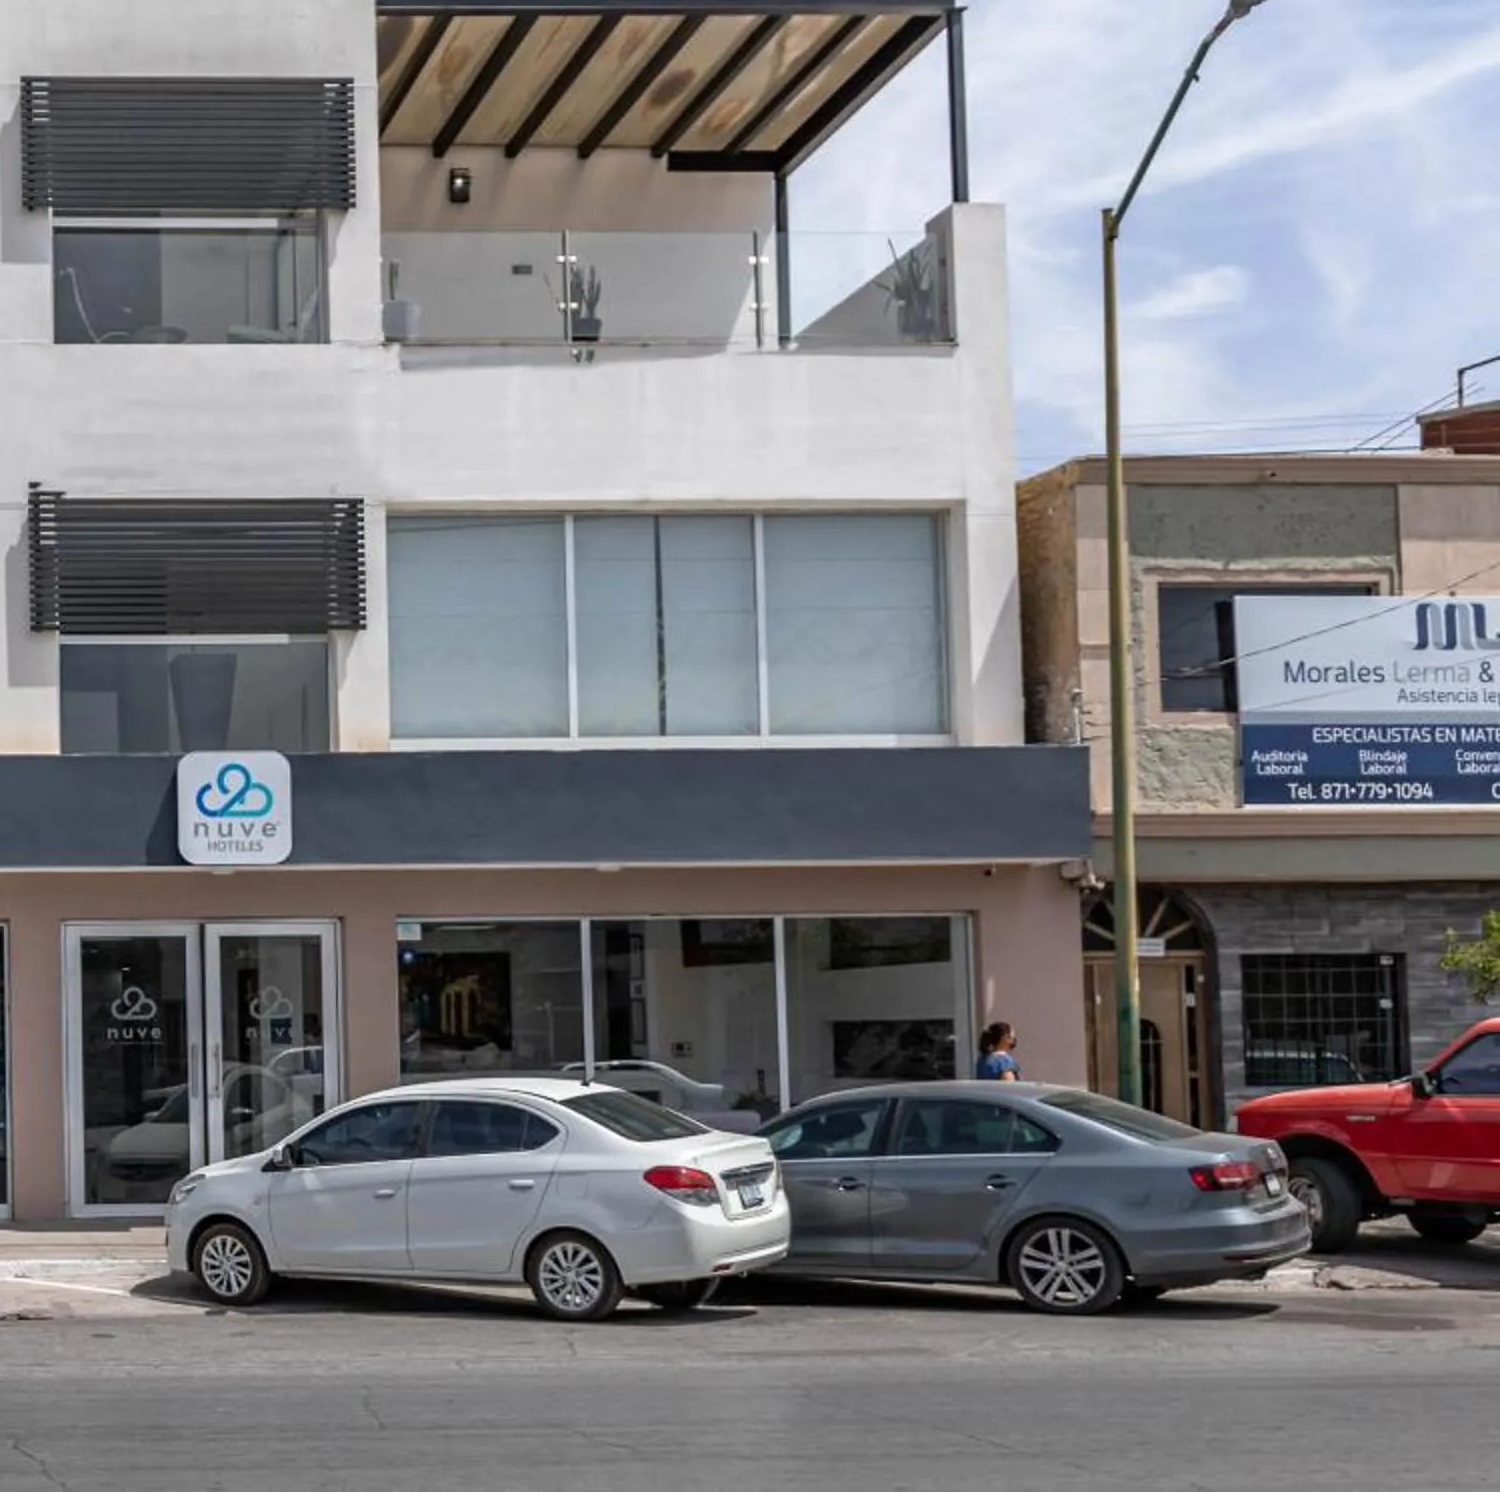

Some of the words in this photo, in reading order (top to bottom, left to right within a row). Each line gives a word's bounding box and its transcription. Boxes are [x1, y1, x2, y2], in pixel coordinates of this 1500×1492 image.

[1283, 660, 1385, 683] Morales
[1392, 660, 1470, 683] Lerma
[1478, 660, 1494, 683] &
[1397, 688, 1478, 704] Asistencia
[1312, 727, 1432, 743] ESPECIALISTAS
[1435, 727, 1457, 743] EN
[1359, 749, 1408, 764] Blindaje
[1257, 763, 1303, 775] Laboral
[1361, 763, 1407, 775] Laboral
[1286, 783, 1317, 800] Tel.
[193, 821, 277, 838] nuve
[208, 840, 264, 852] HOTELES
[106, 1027, 162, 1039] nuve
